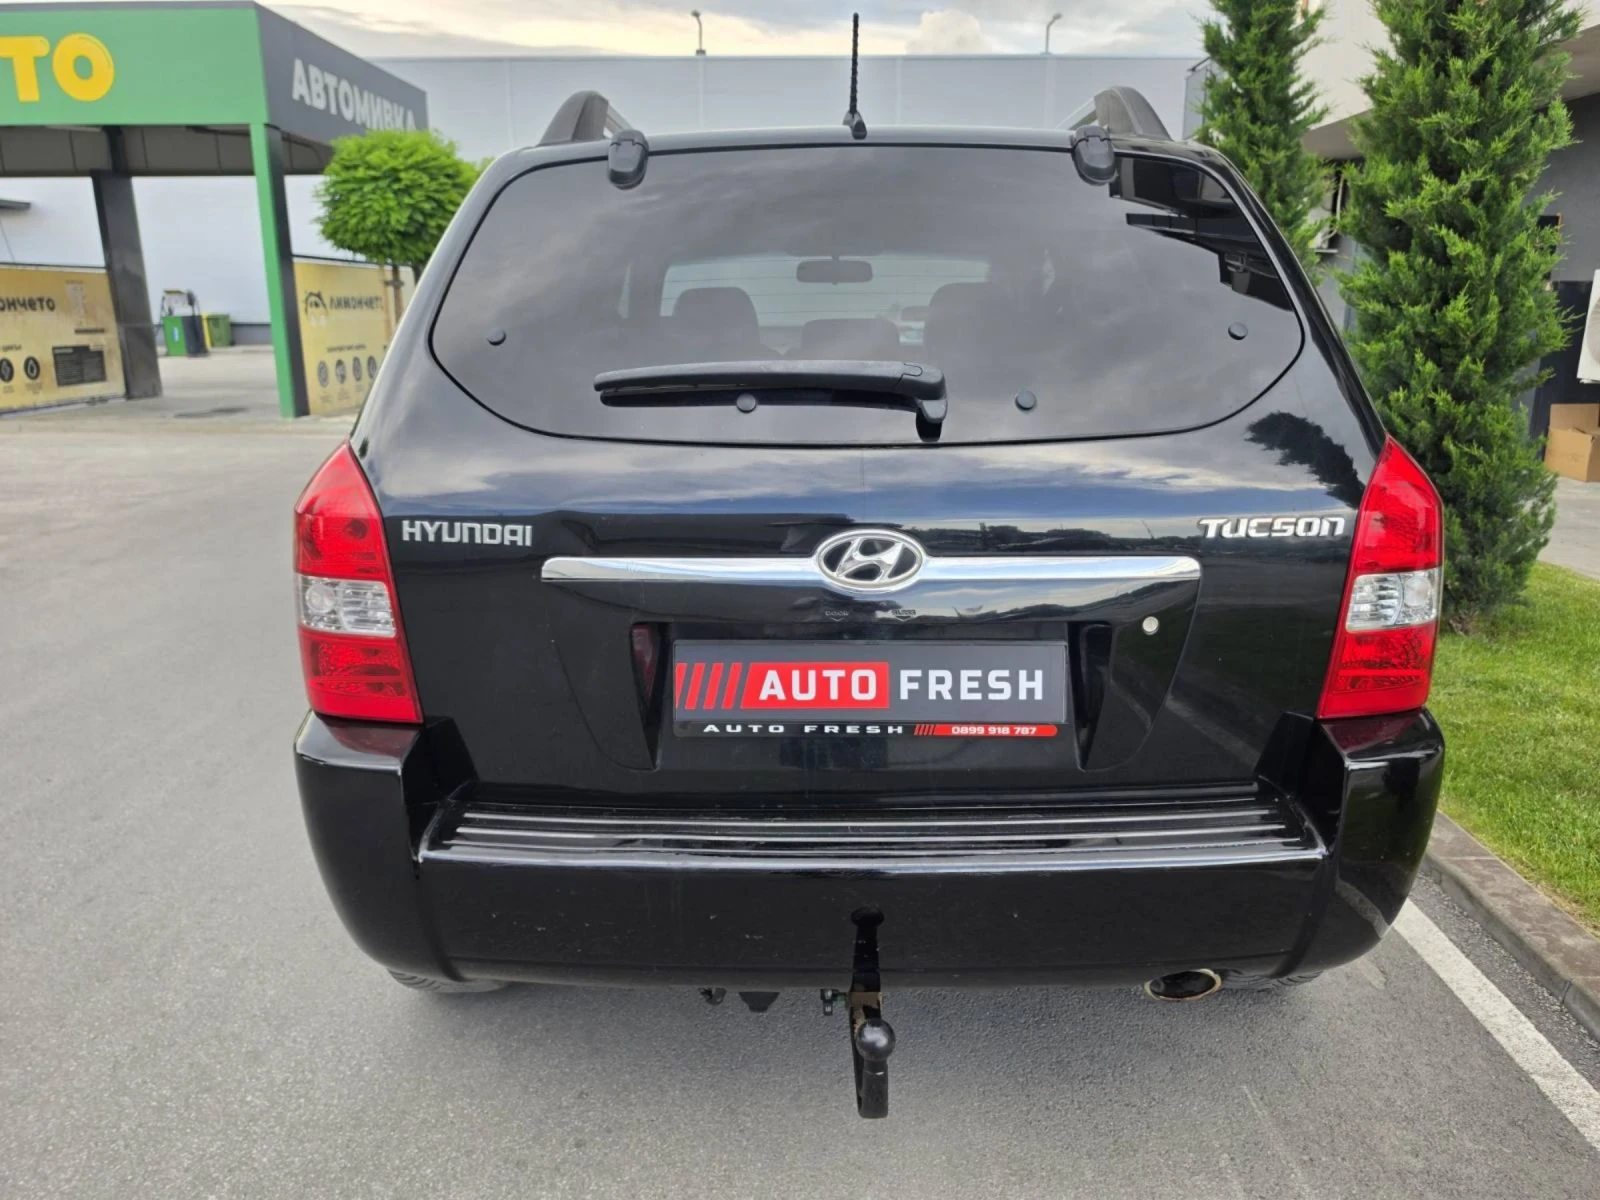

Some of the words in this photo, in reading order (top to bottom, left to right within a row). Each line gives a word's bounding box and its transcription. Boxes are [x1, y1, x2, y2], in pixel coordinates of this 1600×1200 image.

[402, 520, 533, 547] HYUNDAI
[1199, 517, 1346, 539] TUCSON
[758, 669, 876, 701] AUTO
[899, 669, 1044, 700] FRESH
[703, 724, 785, 733] AUTO
[803, 725, 904, 734] FRESH
[951, 726, 985, 735] 0899
[987, 726, 1010, 735] 918
[1013, 726, 1037, 735] 787
